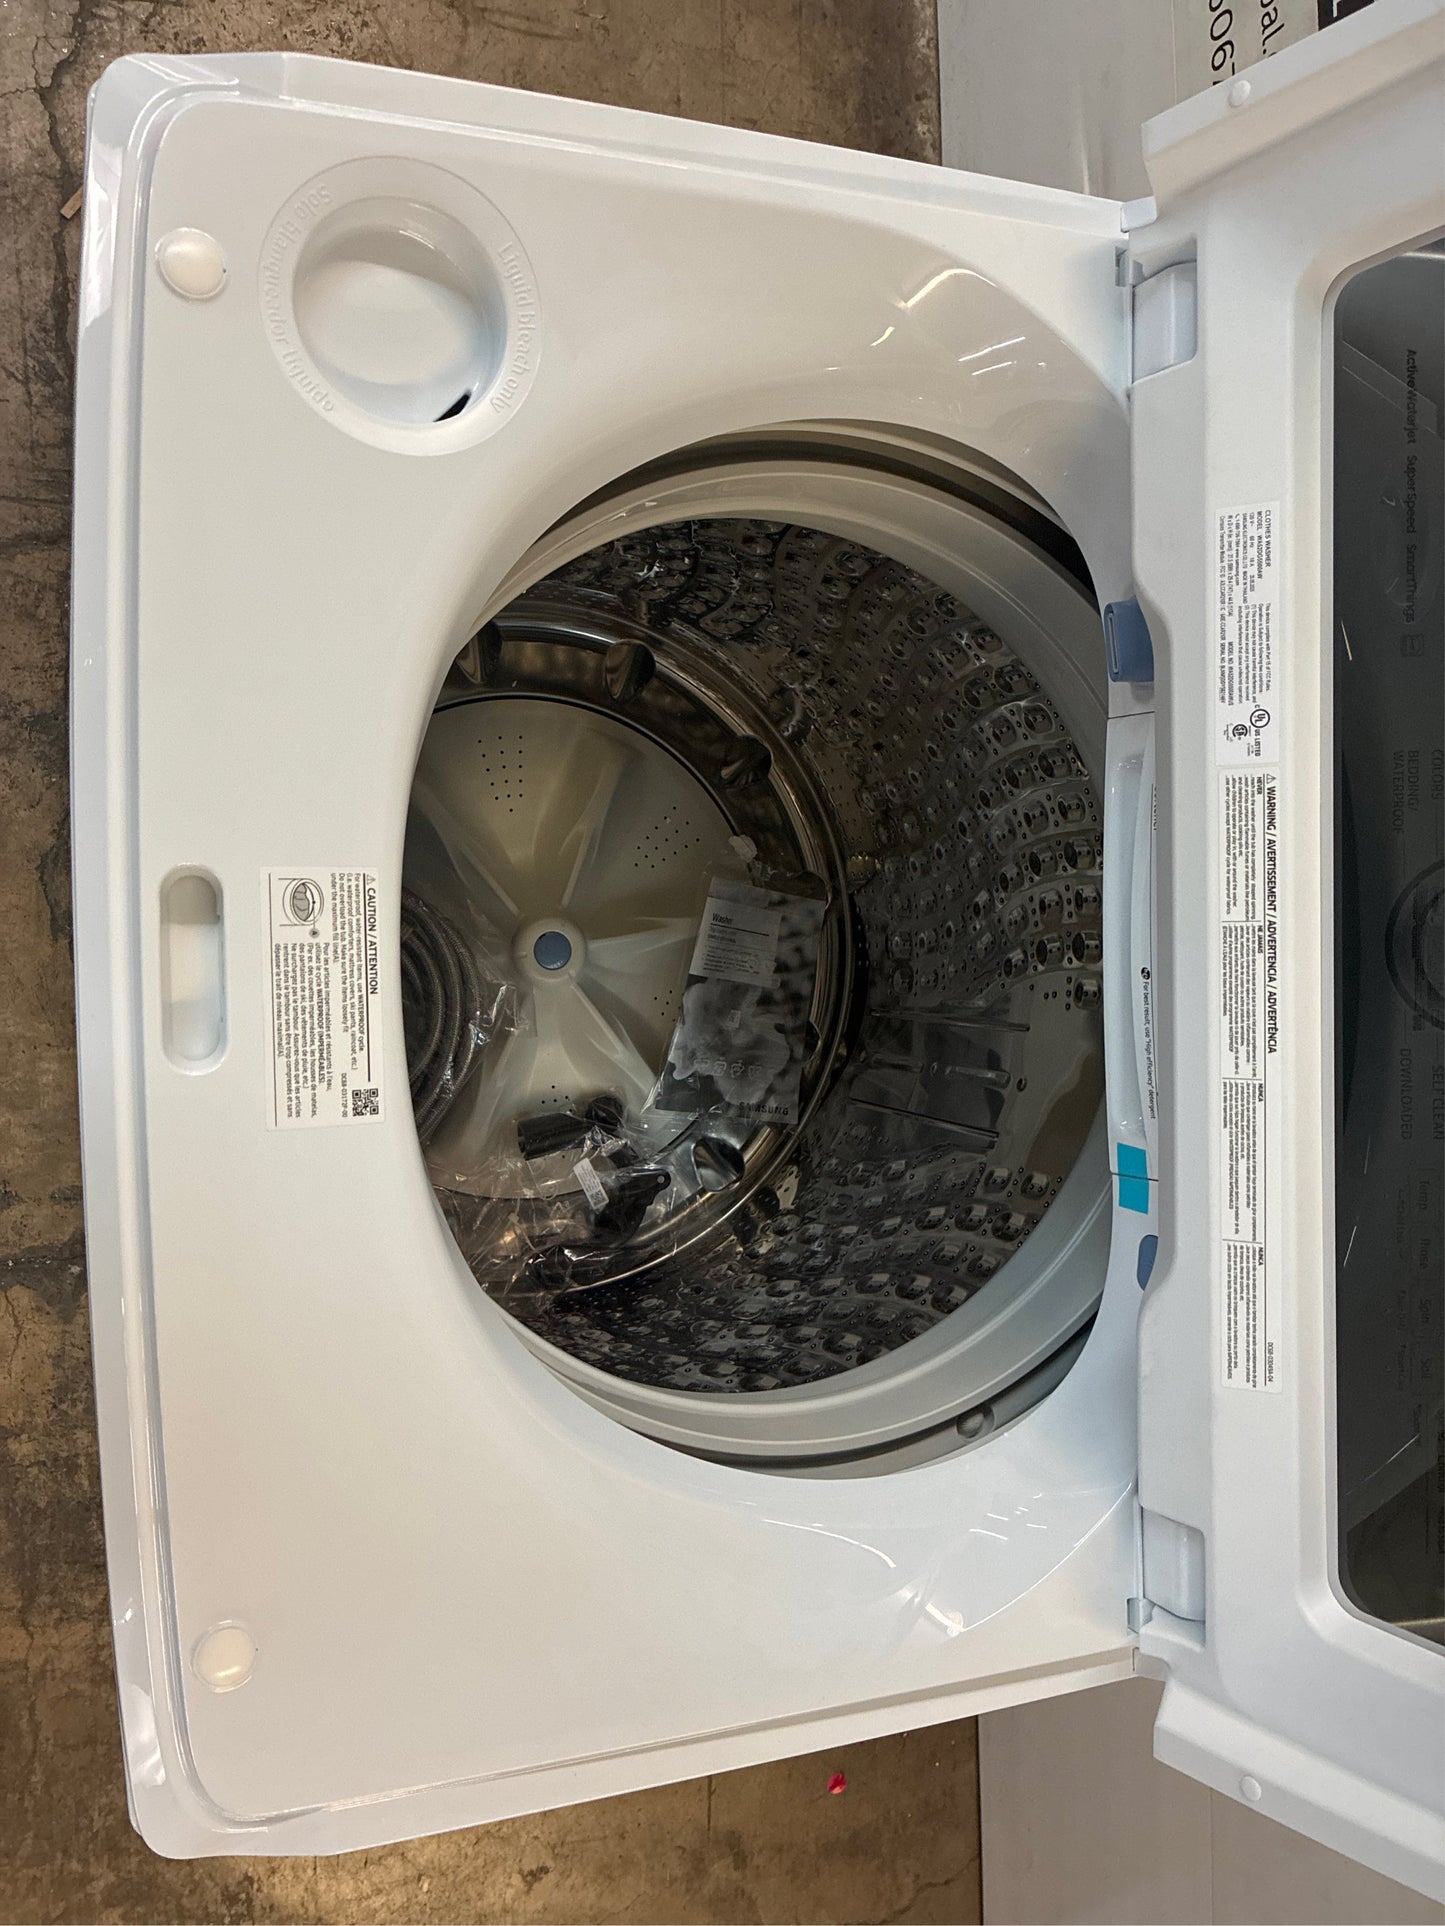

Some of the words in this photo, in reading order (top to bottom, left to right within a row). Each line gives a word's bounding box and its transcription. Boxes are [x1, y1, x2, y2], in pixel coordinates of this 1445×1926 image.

[1209, 0, 1235, 86] 06
[500, 242, 532, 309] Liquid
[516, 312, 536, 380] bleach
[491, 376, 520, 414] only
[1403, 544, 1418, 622] SmartThings
[1392, 750, 1405, 834] WATERPROOF
[1408, 750, 1420, 811] BEDDING/
[1431, 749, 1444, 800] COLORS
[1267, 786, 1276, 830] WARNING
[1267, 839, 1276, 912] AVERTISSEMENT
[367, 888, 376, 931] CAUTION
[369, 940, 378, 994] ATTENTION
[1268, 920, 1277, 982] ADVERTENCIA
[1268, 991, 1278, 1054] ADVERTÊNCIA
[1148, 1089, 1156, 1119] detergent
[1400, 1048, 1413, 1140] DOWNLOADED
[1432, 1066, 1444, 1095] SELF
[1432, 1098, 1444, 1140] CLEAN
